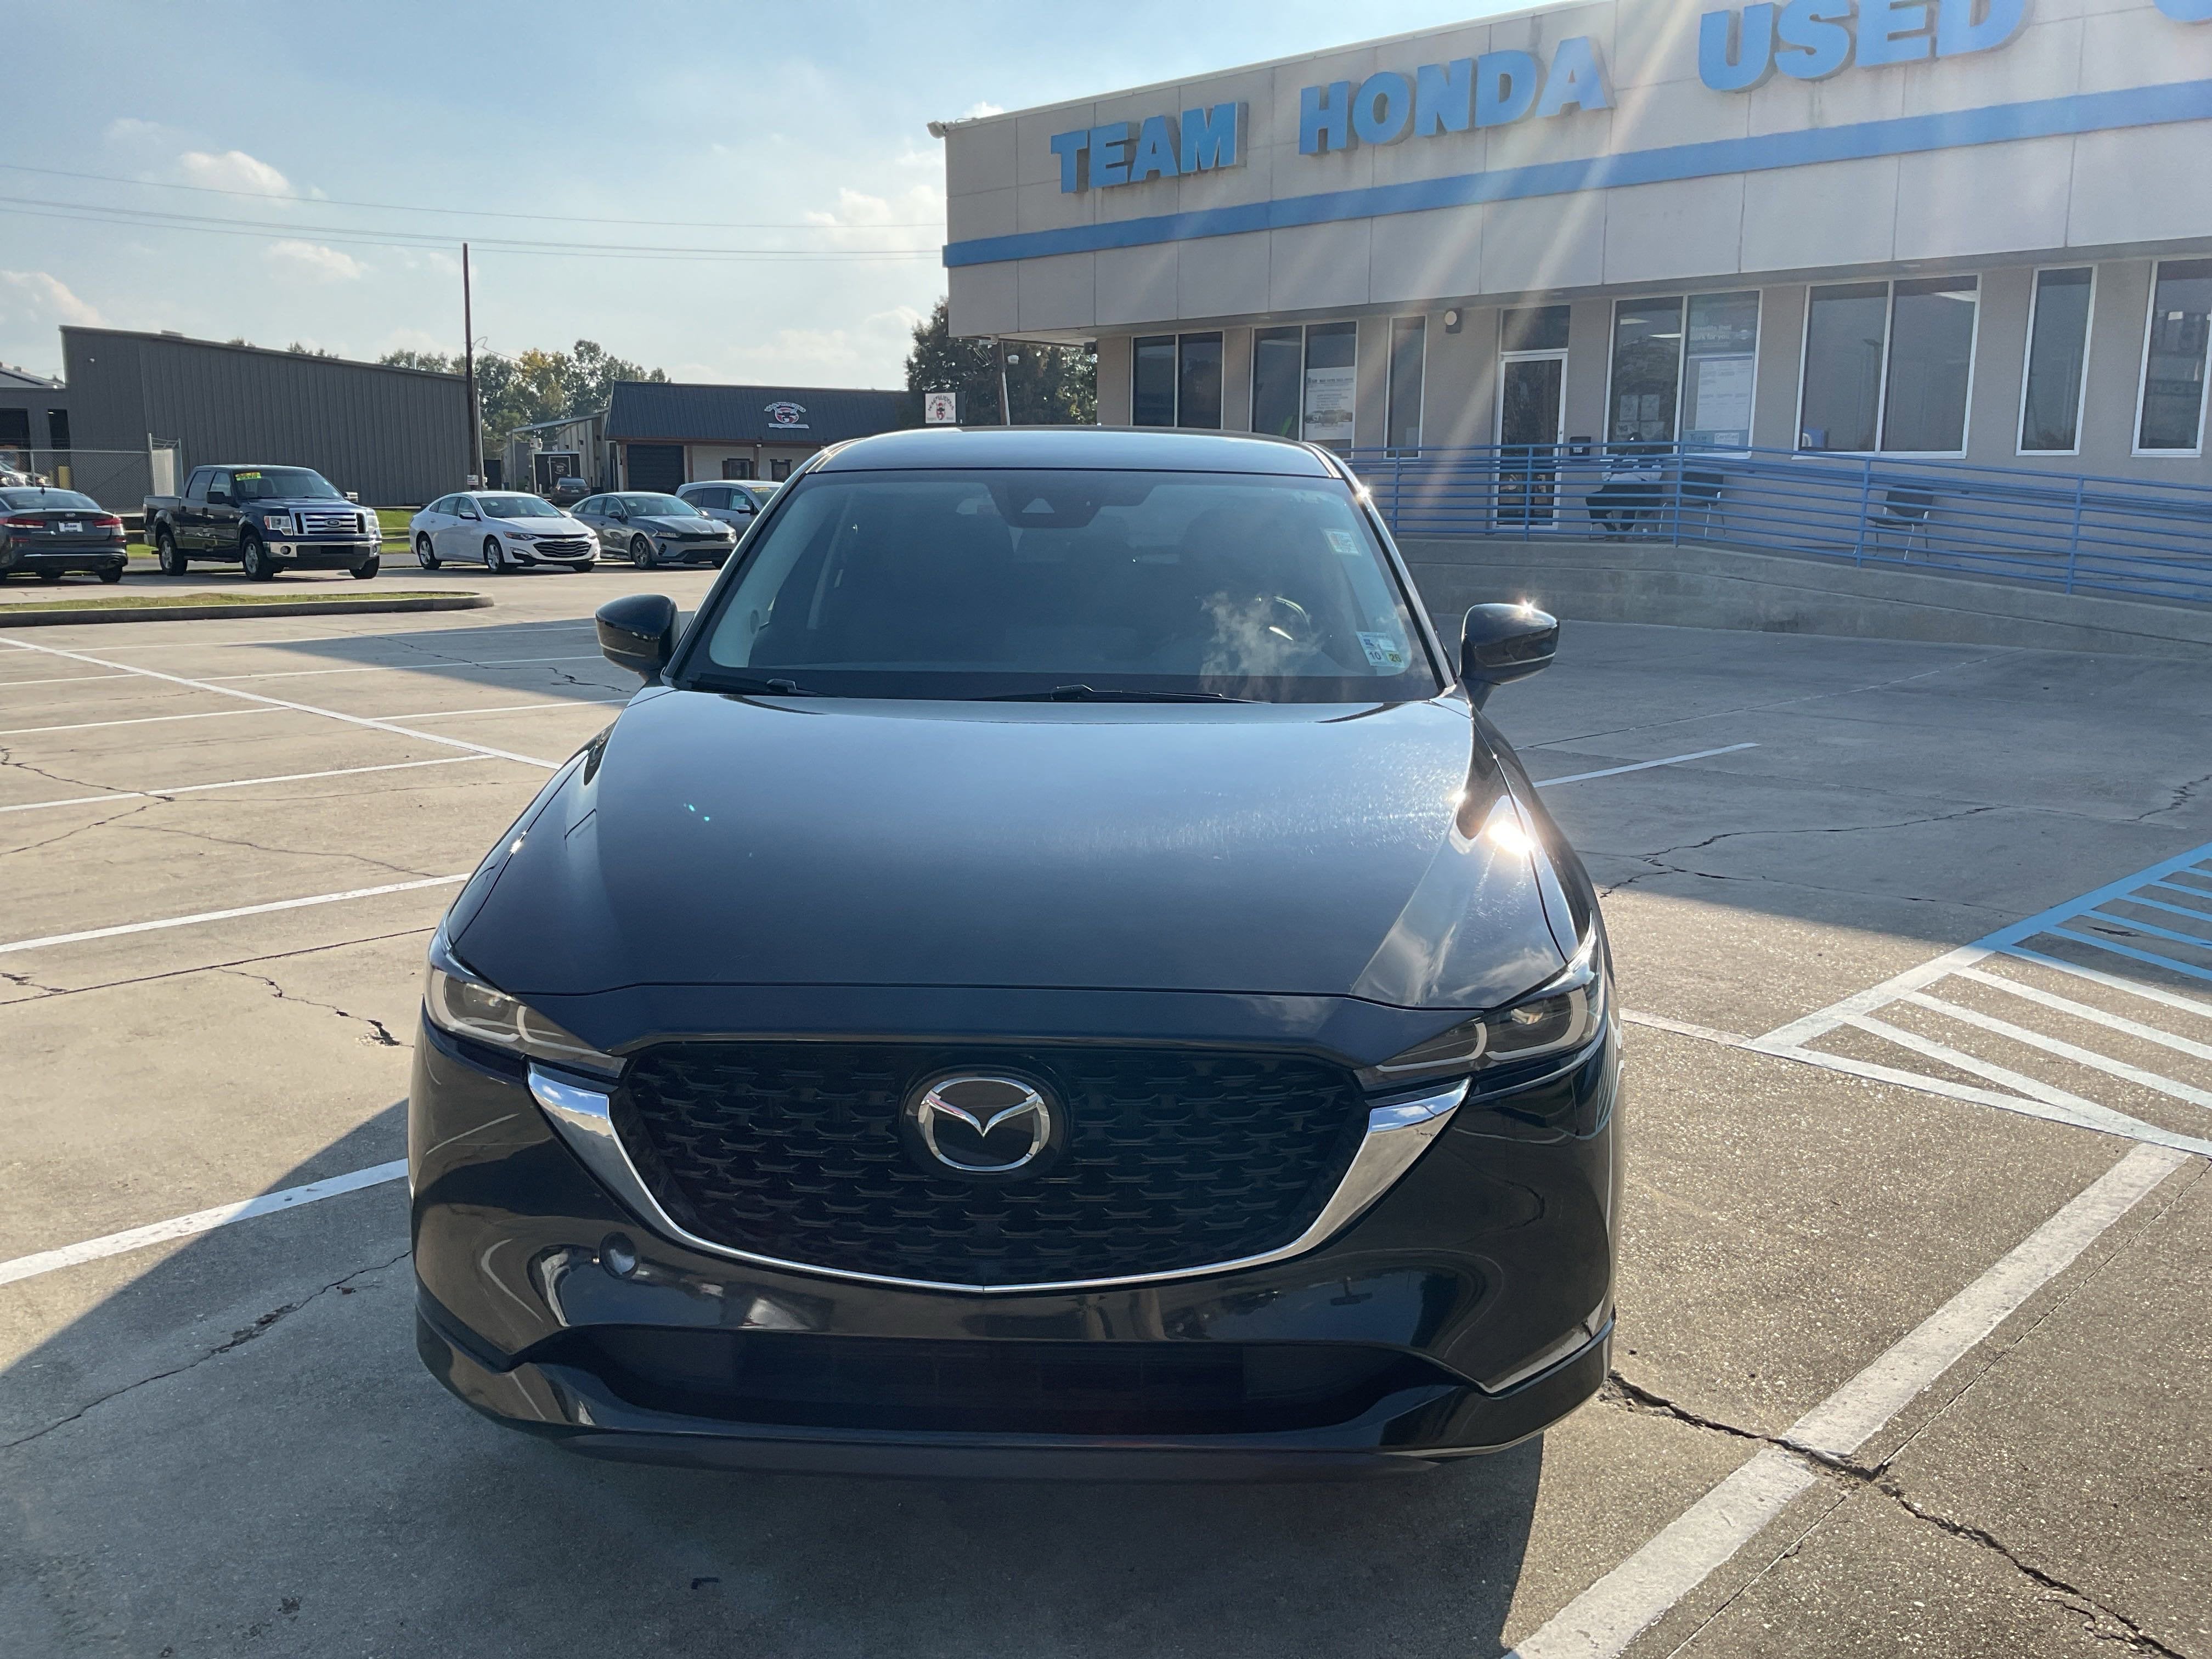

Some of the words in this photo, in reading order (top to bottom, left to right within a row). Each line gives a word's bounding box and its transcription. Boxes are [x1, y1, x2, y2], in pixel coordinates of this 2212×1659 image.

[1051, 102, 1249, 194] TEAM
[1300, 36, 1613, 156] HONDA
[1697, 0, 2035, 93] USED
[1369, 652, 1381, 660] 10
